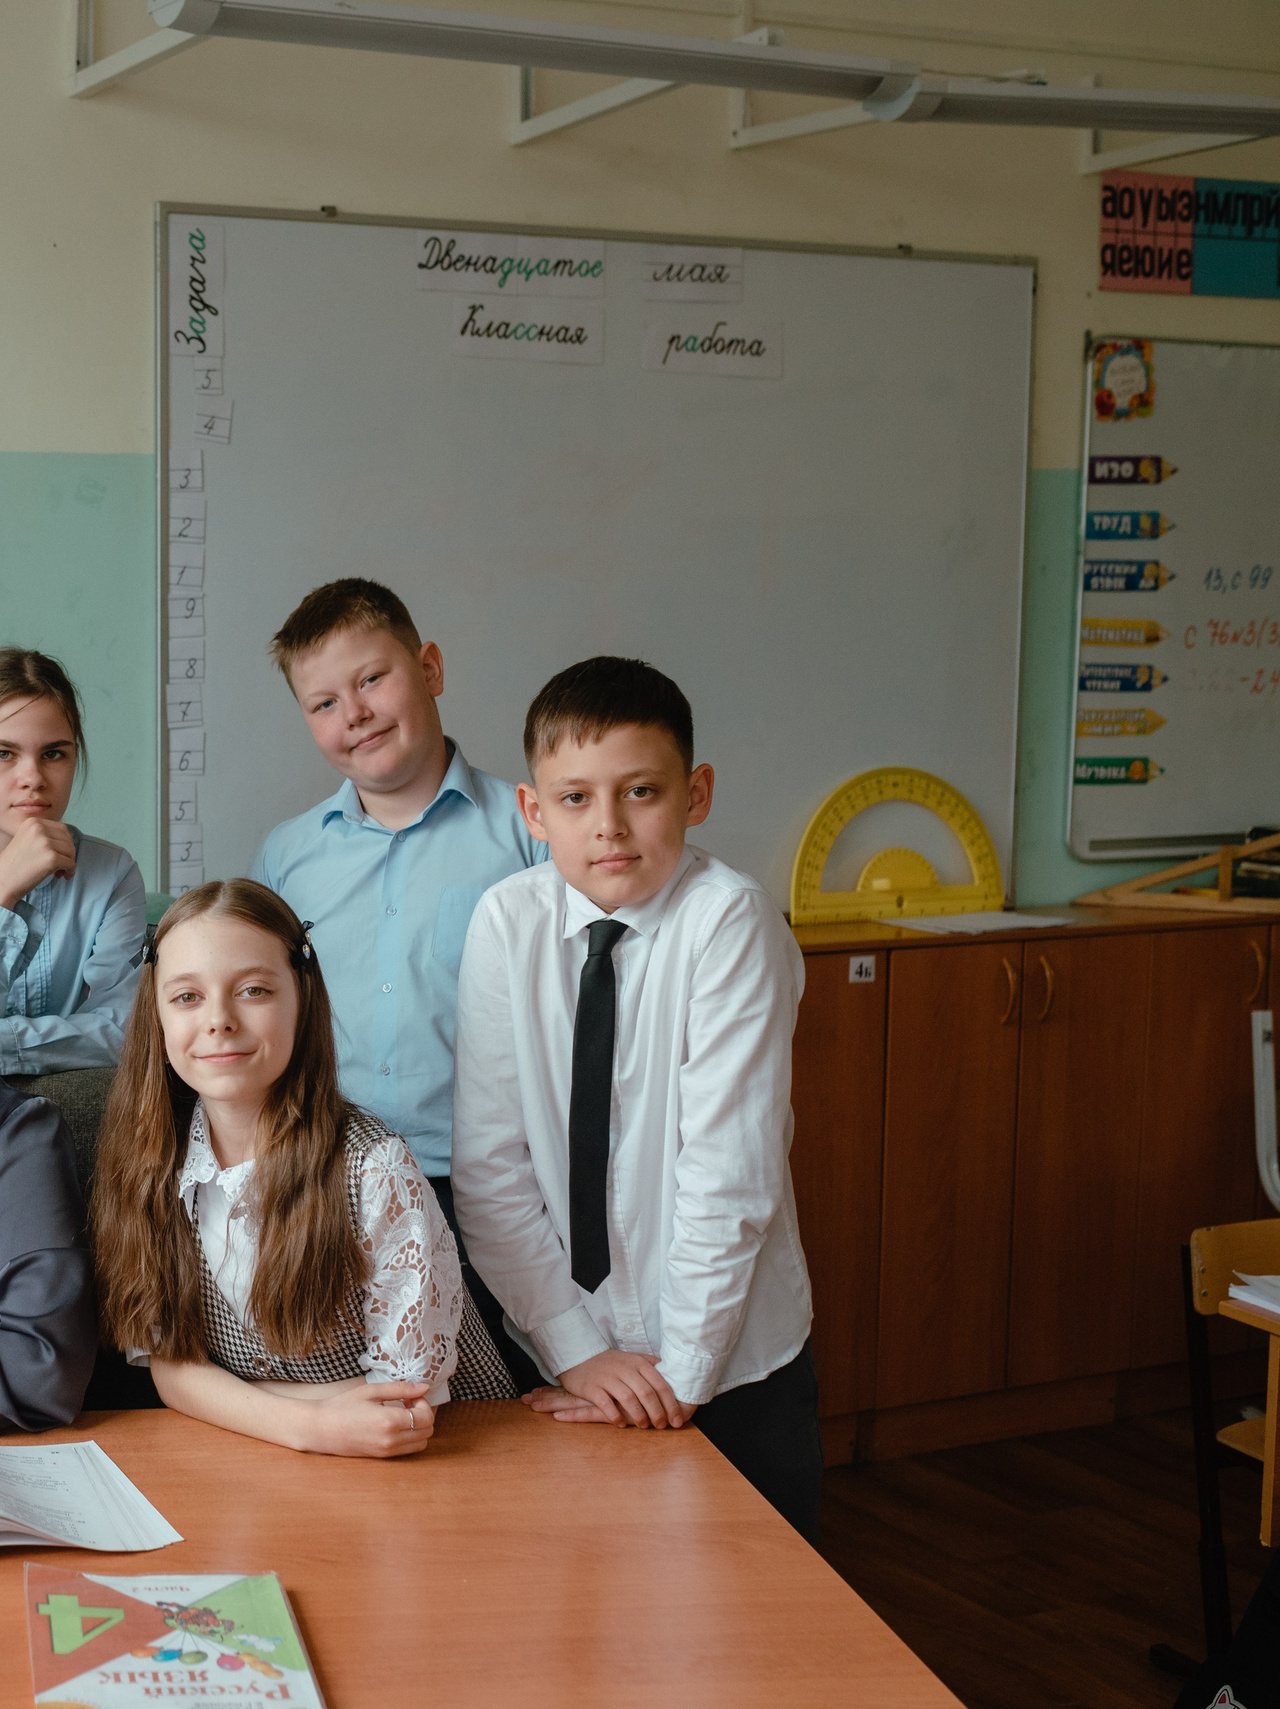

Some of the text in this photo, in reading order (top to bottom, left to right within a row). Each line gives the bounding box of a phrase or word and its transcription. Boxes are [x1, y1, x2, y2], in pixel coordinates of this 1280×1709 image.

[417, 236, 730, 288] Двенадцатое мая
[174, 227, 219, 354] Задача
[460, 303, 767, 366] Классная работа
[201, 369, 217, 390] 5
[203, 415, 216, 435] 4
[179, 468, 192, 489] 3
[1094, 460, 1135, 480] ИЗО
[178, 517, 193, 539] 2
[1092, 514, 1132, 535] ТРУД
[176, 565, 188, 586] 1
[184, 597, 197, 619] 9
[185, 658, 198, 680] 8
[178, 701, 192, 723] 7
[178, 750, 191, 772] 6
[174, 801, 191, 822] 5
[179, 841, 193, 862] 3
[36, 1593, 125, 1655] 4
[143, 1679, 293, 1701] Русский
